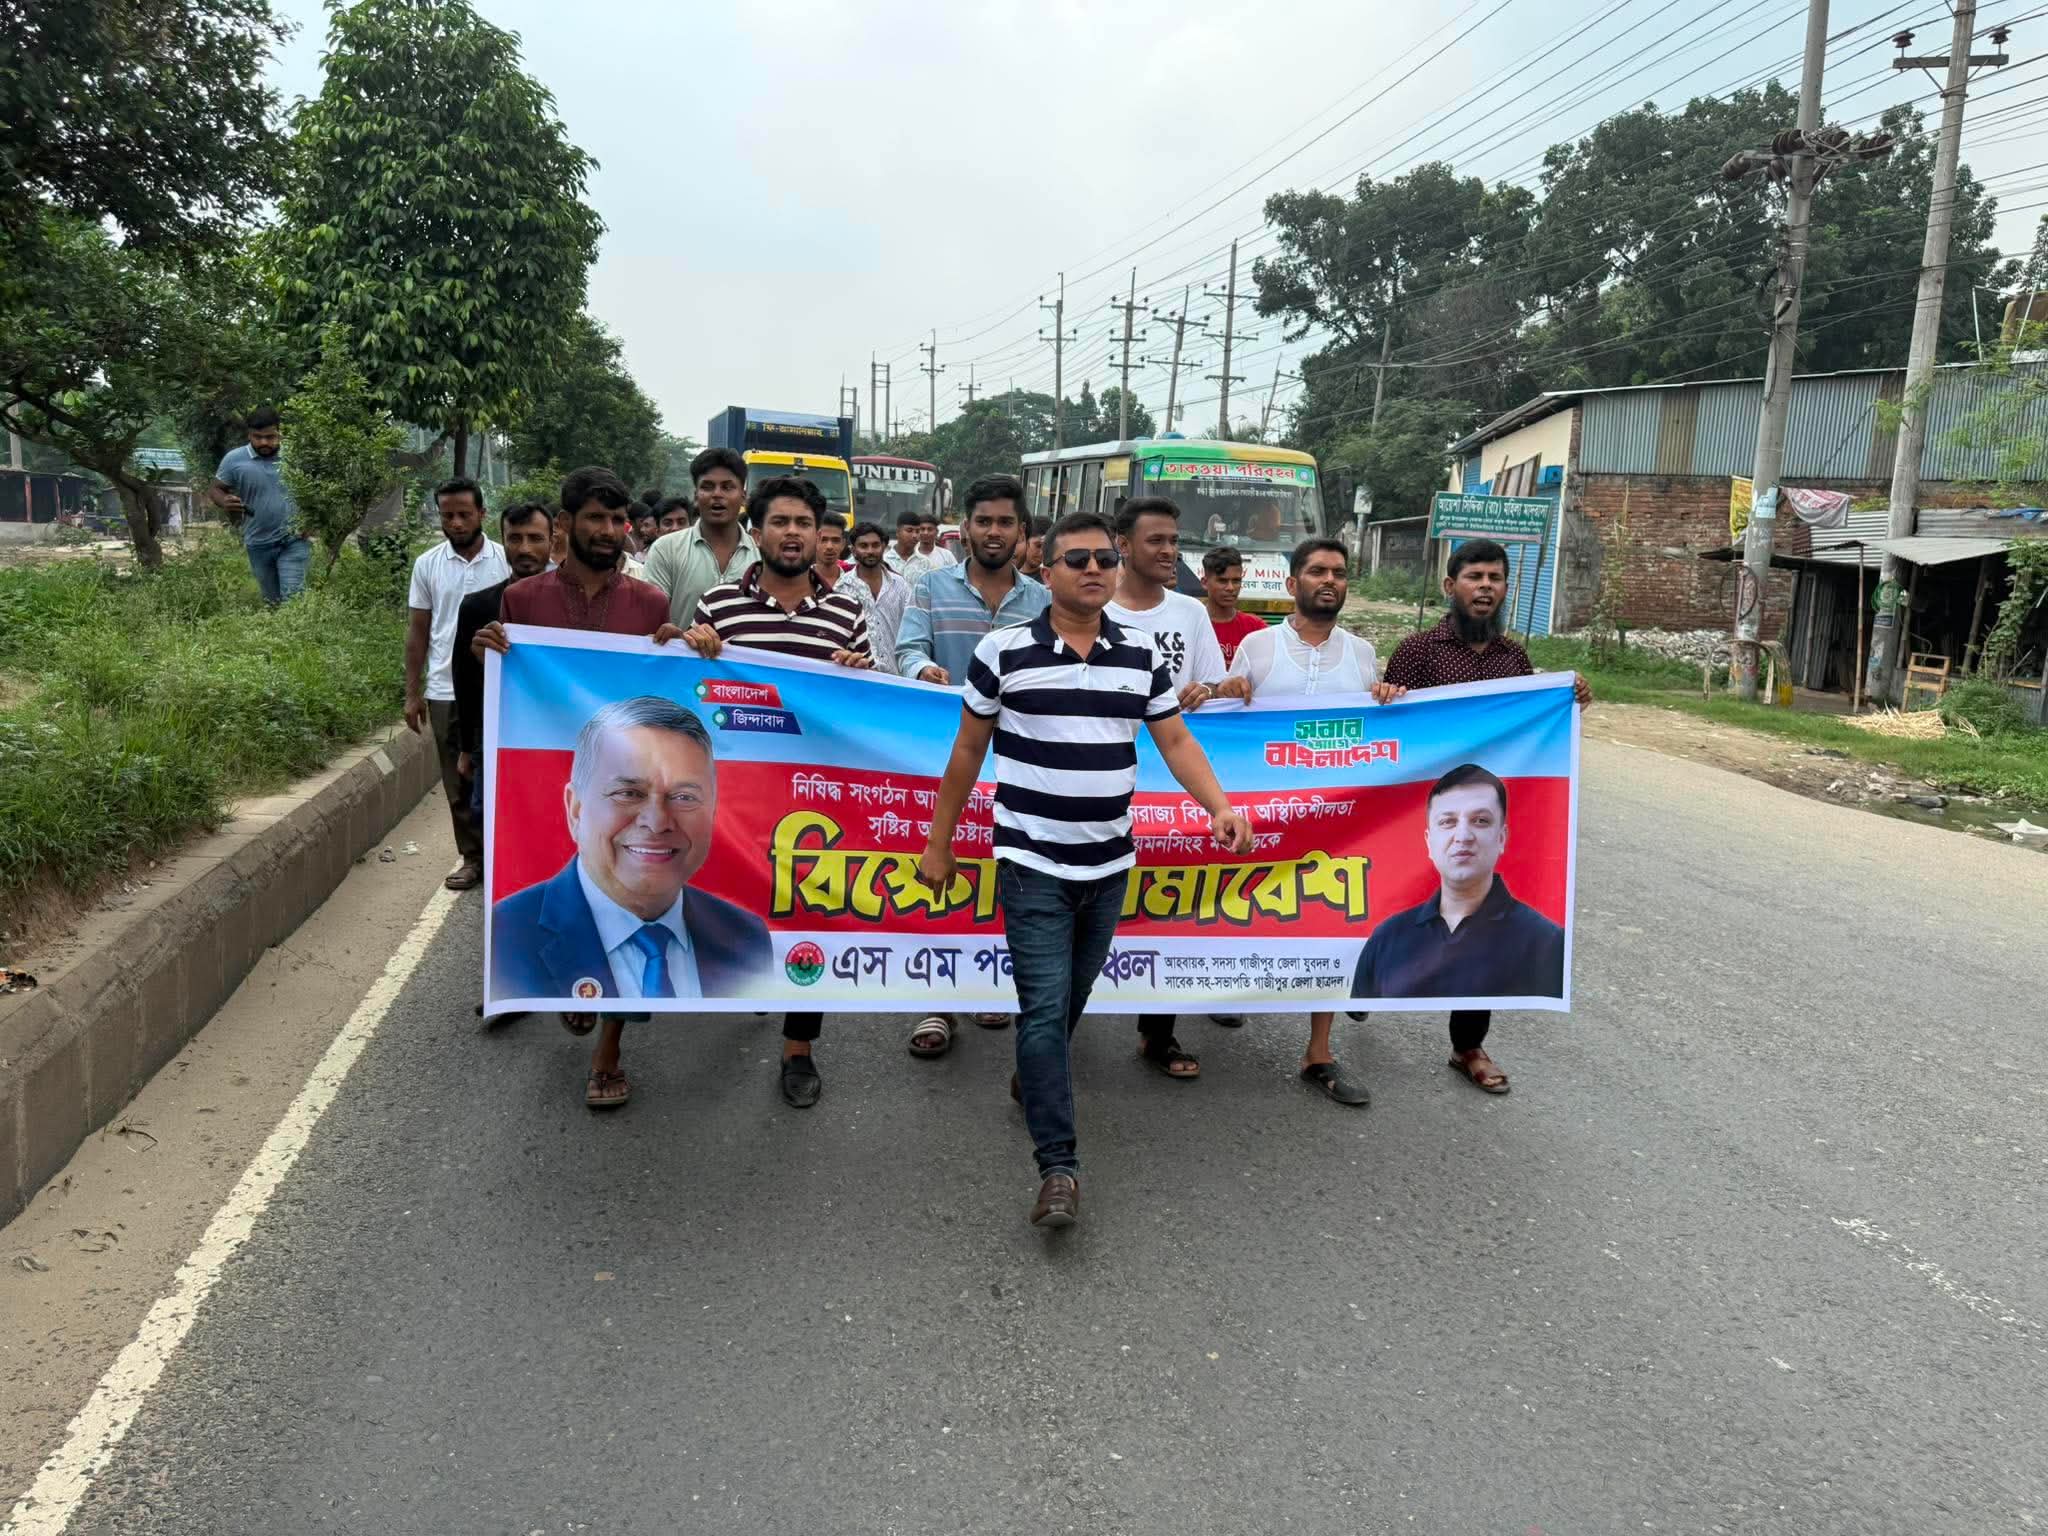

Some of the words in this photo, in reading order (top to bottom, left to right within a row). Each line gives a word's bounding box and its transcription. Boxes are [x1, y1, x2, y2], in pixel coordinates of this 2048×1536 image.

[853, 464, 936, 484] UNITED
[1165, 463, 1229, 475] তাকওয়া
[1236, 463, 1296, 479] পরিবহন
[1254, 569, 1286, 579] MINI
[711, 684, 769, 701] বাংলাদেশ
[732, 708, 786, 728] জিন্দাবাদ
[1294, 717, 1364, 740] সবার
[1264, 739, 1400, 769] বাংলাদেশ
[792, 772, 844, 800] নিষিদ্ধ
[849, 779, 910, 806] সংগঠন
[1254, 794, 1357, 825] অস্থিতিশীলতা
[868, 811, 912, 844] সৃষ্টির
[832, 946, 894, 987] এস
[905, 946, 963, 988] এম
[1211, 956, 1237, 970] সদস্য
[1239, 953, 1274, 972] গাজীপুর
[1277, 957, 1301, 970] জেলা
[1303, 957, 1330, 973] যুবদল
[1333, 958, 1341, 970] ও
[1164, 975, 1194, 989] সাবেক
[1196, 973, 1251, 990] সহ-সভাপতি
[1253, 972, 1288, 992] গাজীপুর
[1291, 975, 1313, 989] জেলা
